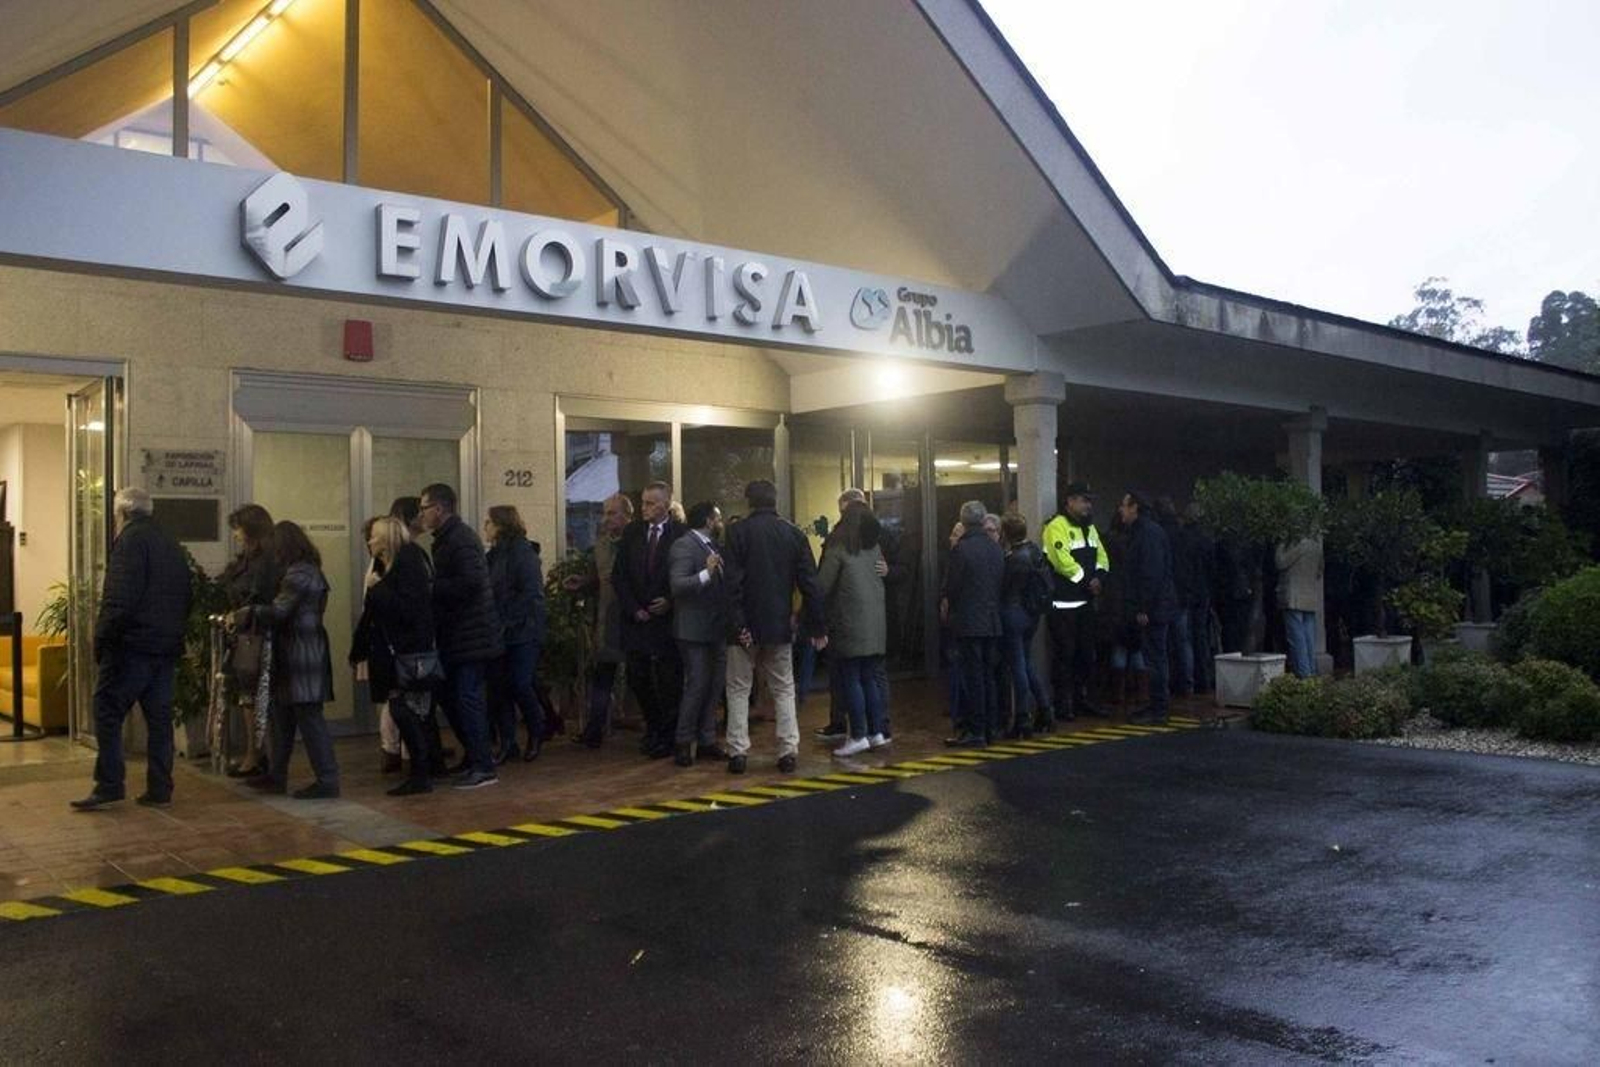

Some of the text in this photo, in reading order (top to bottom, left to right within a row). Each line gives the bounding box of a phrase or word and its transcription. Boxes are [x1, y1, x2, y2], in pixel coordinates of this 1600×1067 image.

[375, 202, 822, 334] EMORVISA
[897, 286, 938, 308] Grupo
[889, 305, 975, 354] Albia
[172, 476, 213, 487] CAPILLA
[503, 469, 534, 488] 212
